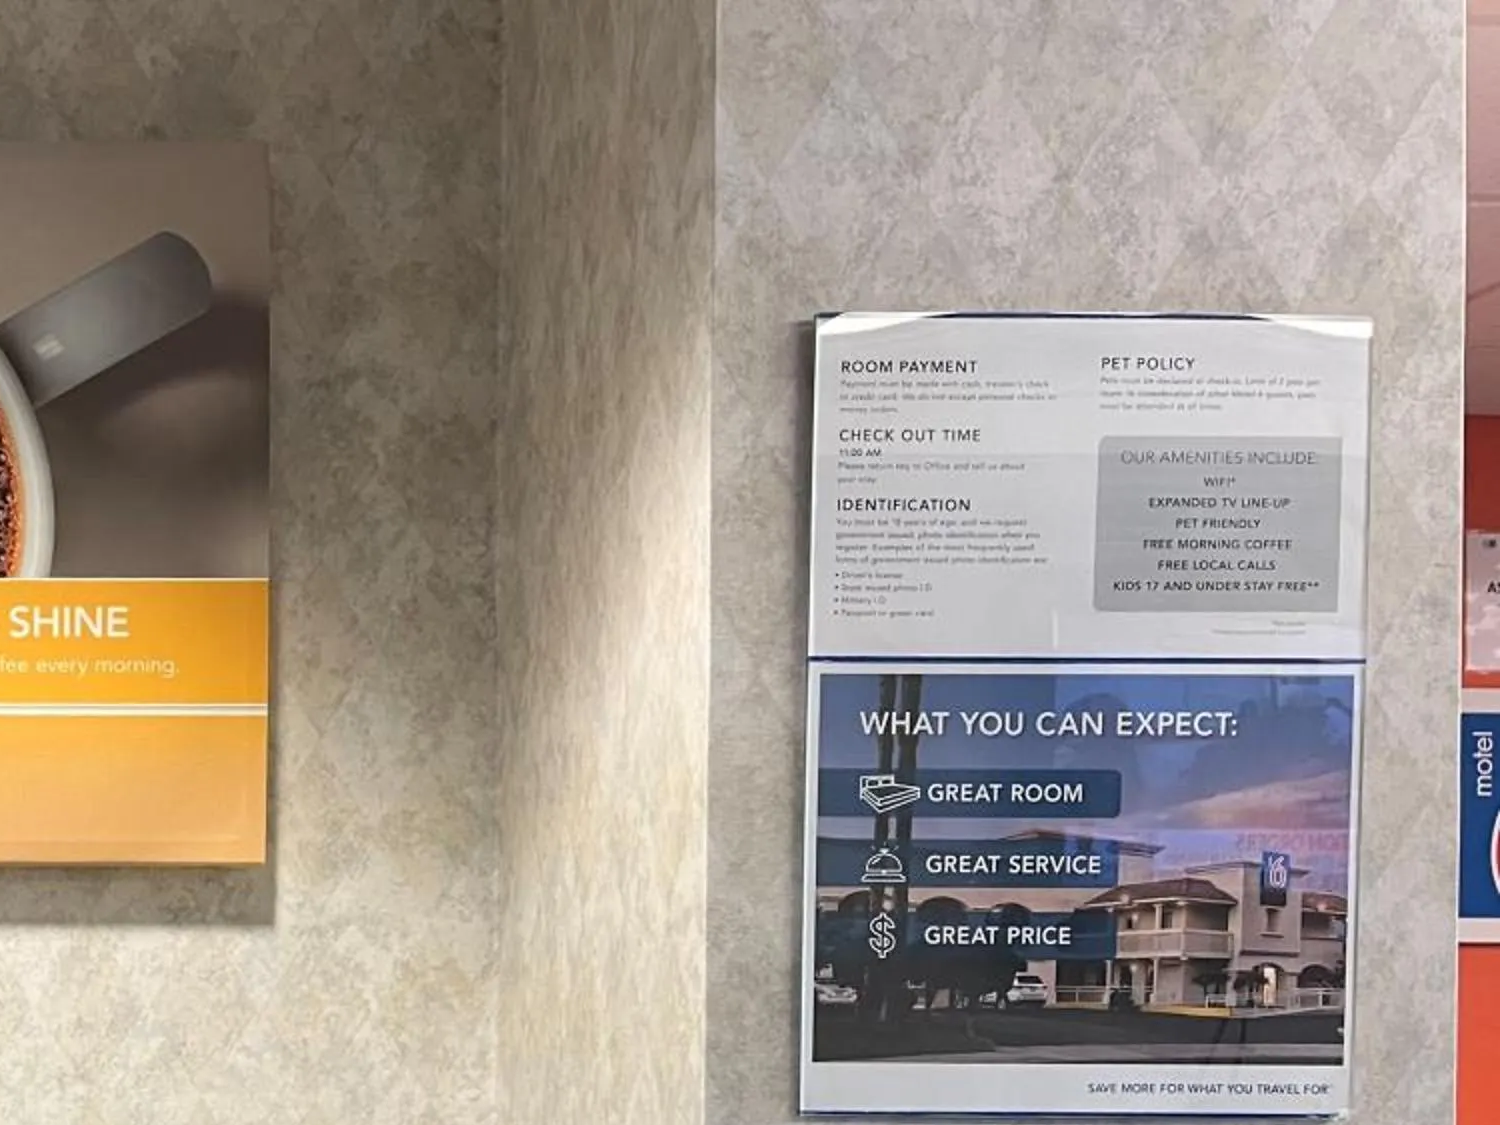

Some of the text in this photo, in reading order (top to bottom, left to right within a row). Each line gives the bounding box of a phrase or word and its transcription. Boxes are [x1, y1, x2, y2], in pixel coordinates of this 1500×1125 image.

[841, 360, 978, 373] ROOM PAYMENT
[1101, 357, 1195, 370] PET POLICY
[839, 429, 980, 442] CHECK OUT TIME
[1121, 451, 1156, 464] OUR
[1160, 451, 1243, 464] AMENITIES
[837, 498, 971, 512] IDENTIFICATION
[1149, 497, 1292, 509] EXPANDED TV LINE-UP
[1176, 518, 1261, 529] PET FRIENDLY
[1143, 539, 1292, 550] FREE MORNING COFFEE
[1157, 560, 1276, 571] FREE LOCAL CALLS
[1113, 581, 1141, 592] KIDS
[1146, 581, 1158, 592] 17
[1163, 581, 1192, 592] AND
[1196, 581, 1240, 592] UNDER
[1244, 581, 1273, 592] STAY
[9, 606, 130, 638] SHINE
[36, 658, 88, 678] every
[94, 657, 180, 679] morning.
[860, 711, 1238, 737] WHAT YOU CAN EXPECT:
[1472, 731, 1493, 797] motel
[927, 783, 1084, 802] GREAT ROOM
[926, 855, 1101, 874] GREAT SERVICE
[924, 926, 1071, 945] GREAT PRICE
[1088, 1083, 1116, 1094] SAVE
[1121, 1083, 1156, 1094] MORE
[1160, 1083, 1185, 1094] FOR
[1188, 1083, 1224, 1094] WHAT
[1227, 1083, 1252, 1095] YOU
[1258, 1083, 1300, 1095] TRAVEL
